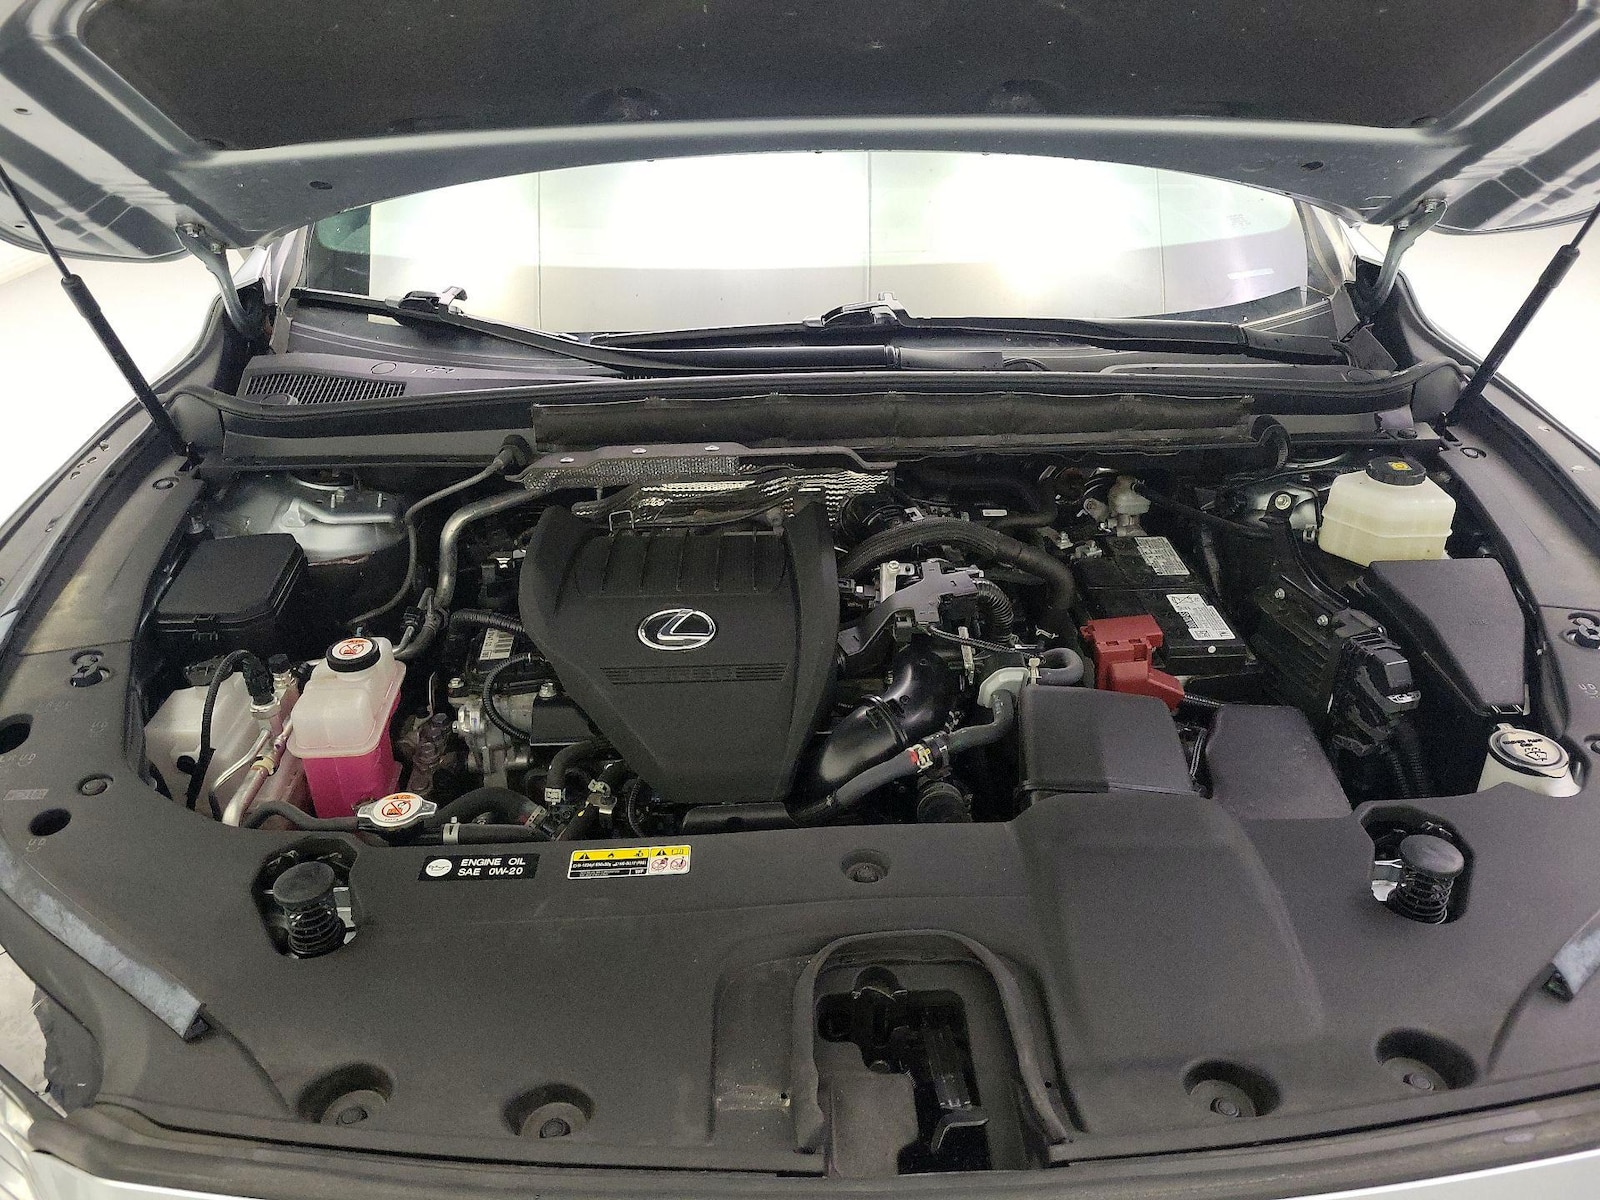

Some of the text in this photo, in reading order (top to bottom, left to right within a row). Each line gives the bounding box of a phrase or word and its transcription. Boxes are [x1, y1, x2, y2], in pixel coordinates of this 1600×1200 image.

[460, 857, 526, 867] ENGINE OIL
[457, 867, 524, 876] SAE 0W-20
